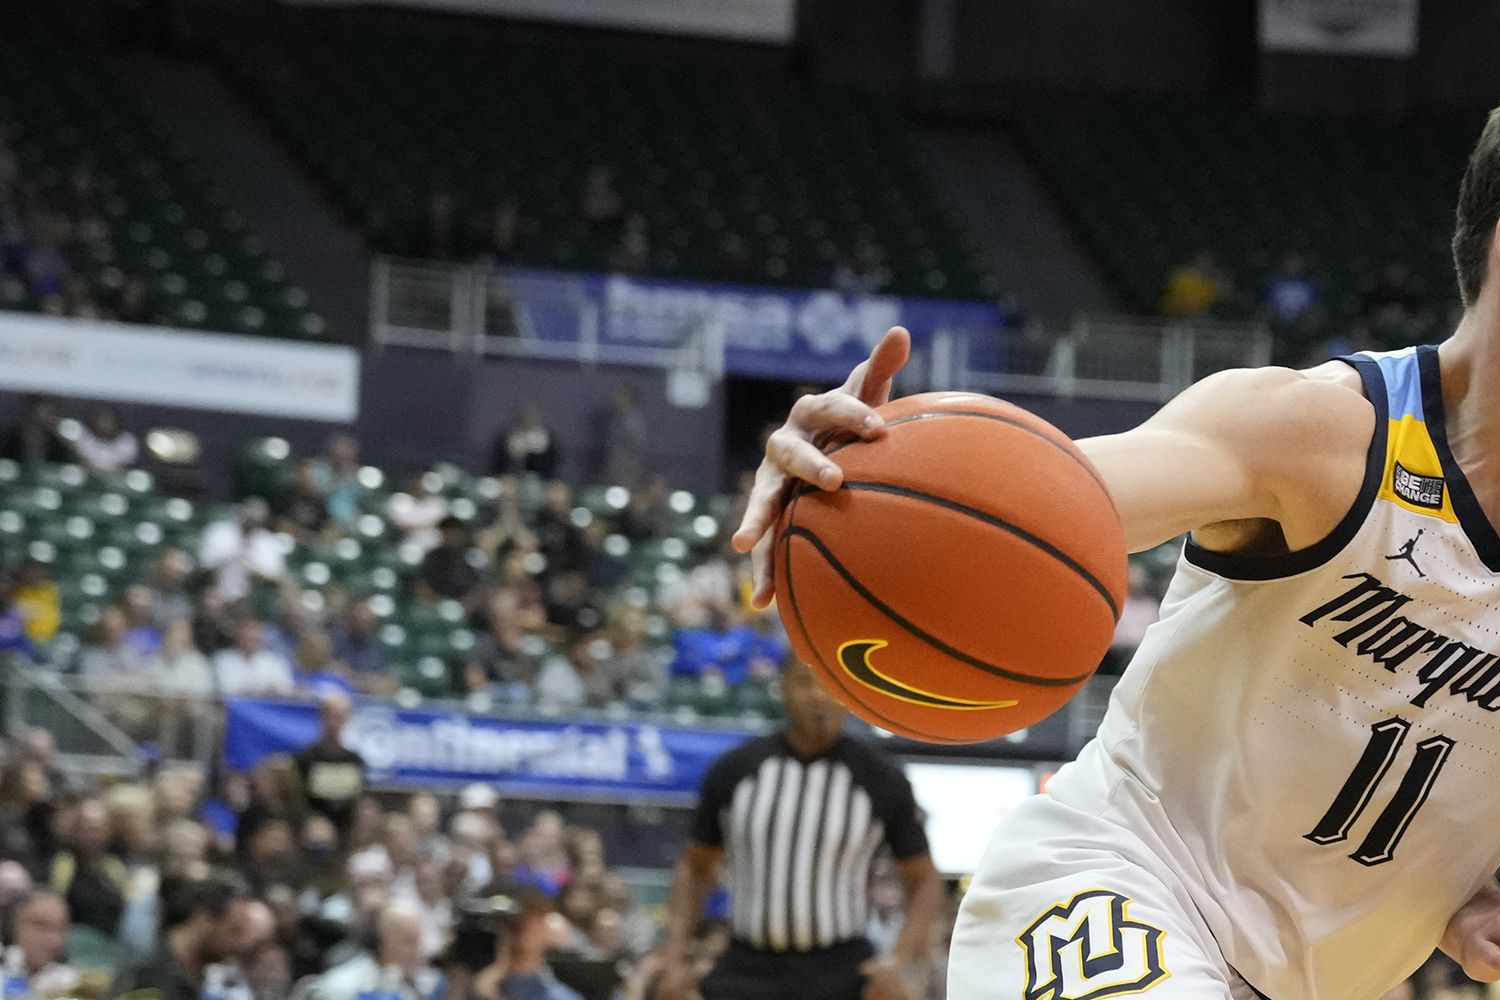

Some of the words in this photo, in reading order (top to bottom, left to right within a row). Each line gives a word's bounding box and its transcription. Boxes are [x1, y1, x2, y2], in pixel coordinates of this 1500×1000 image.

[1400, 469, 1421, 490] BE
[1395, 480, 1441, 504] CHANGE
[1302, 716, 1457, 867] 11
